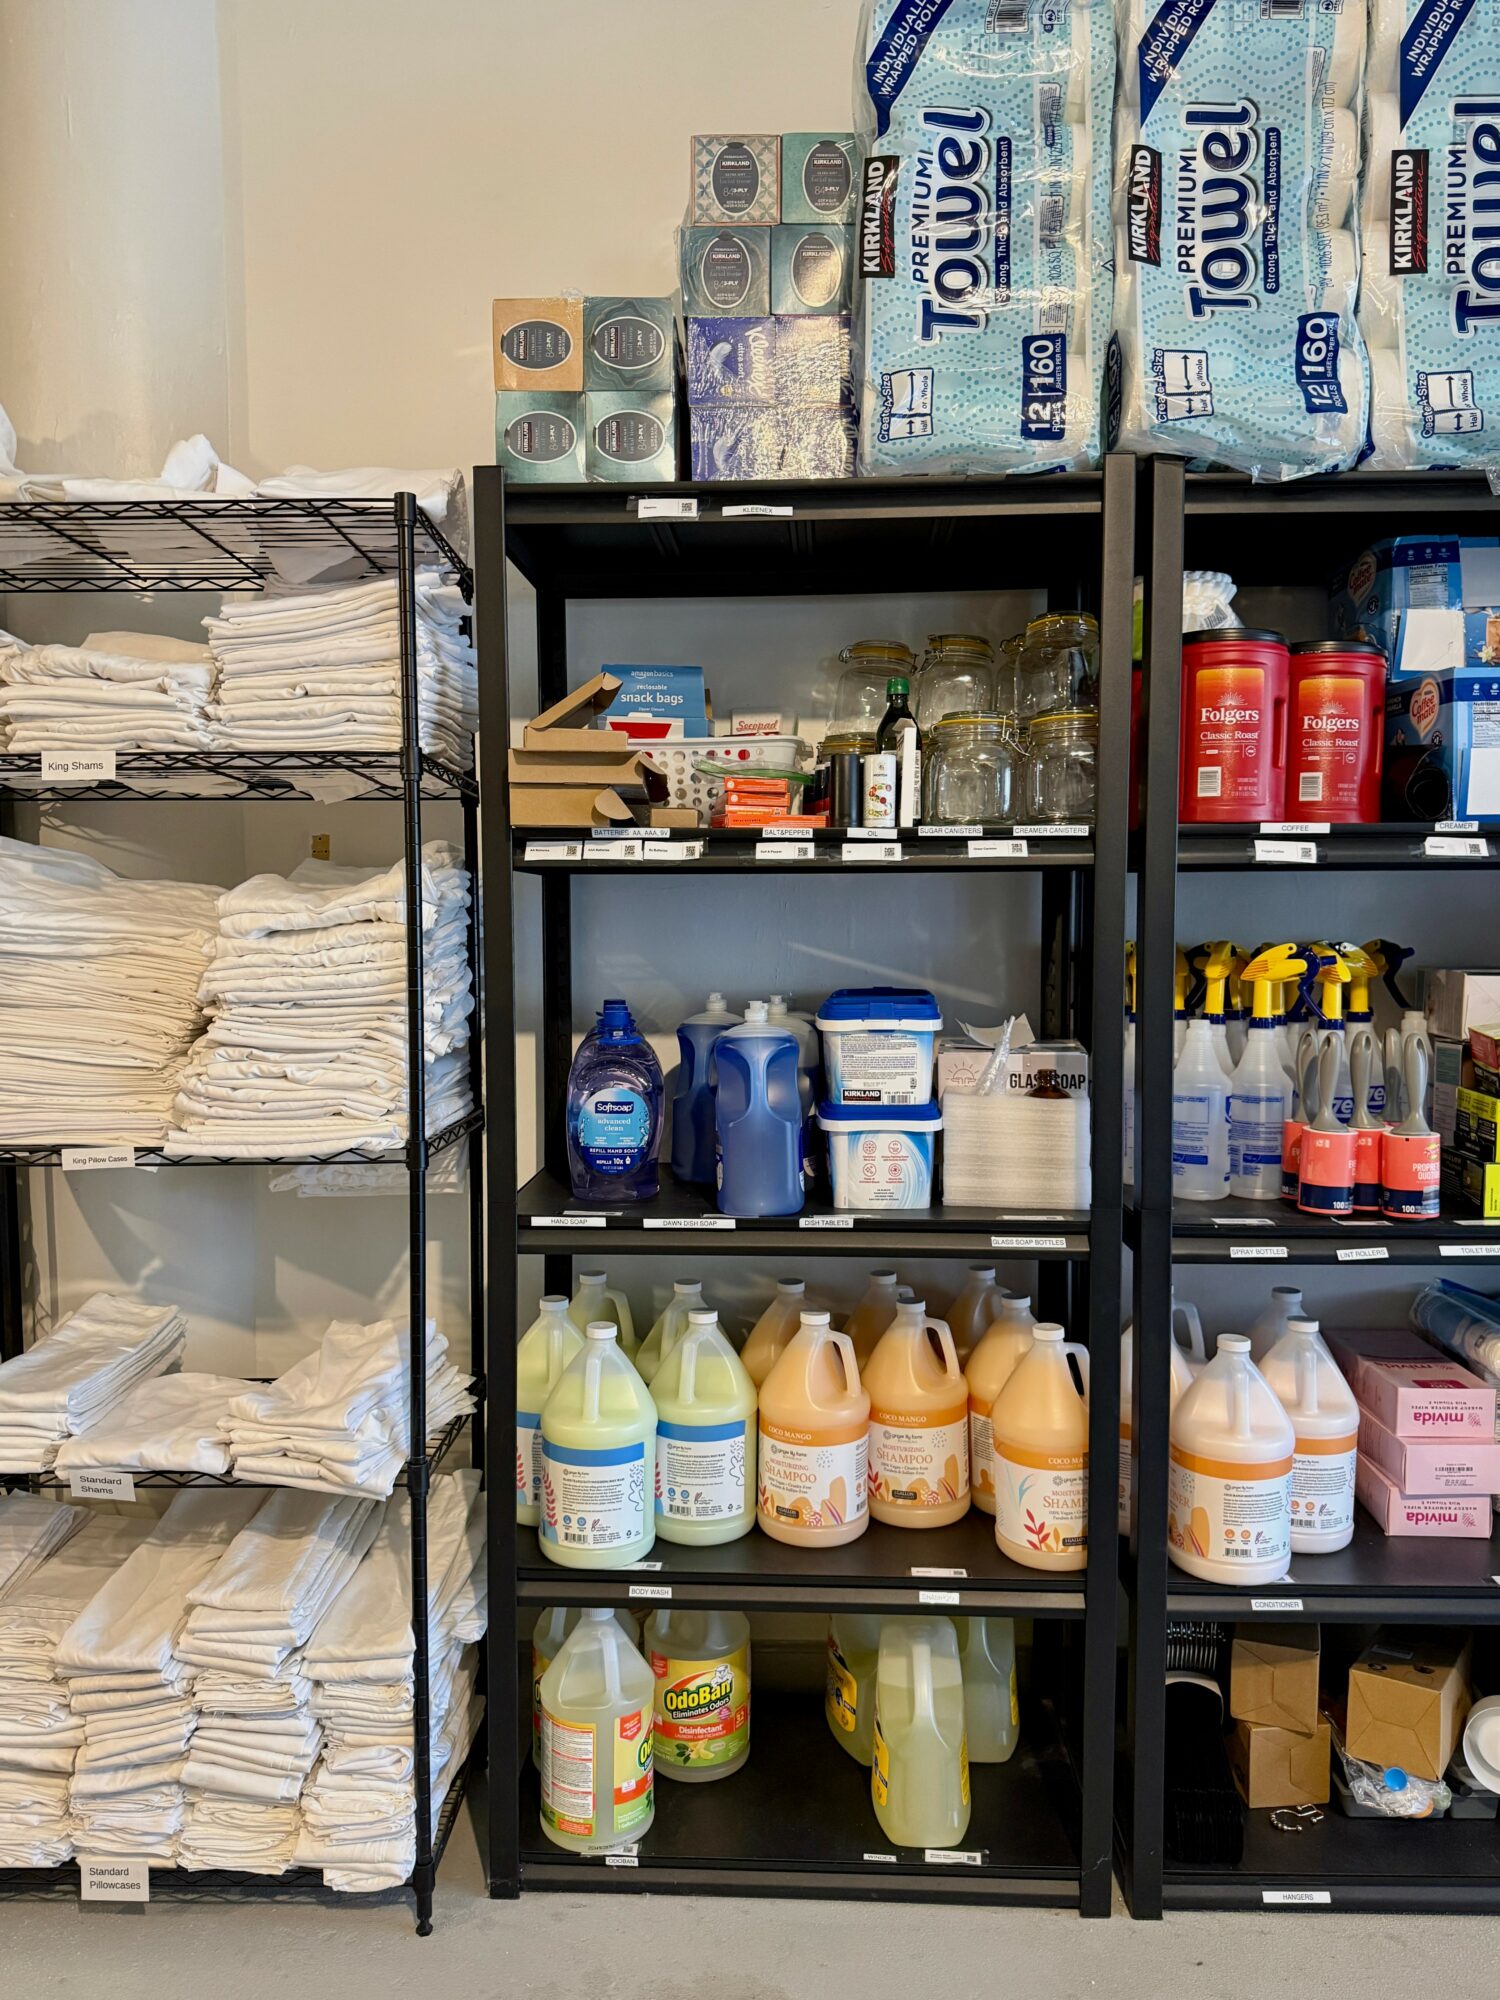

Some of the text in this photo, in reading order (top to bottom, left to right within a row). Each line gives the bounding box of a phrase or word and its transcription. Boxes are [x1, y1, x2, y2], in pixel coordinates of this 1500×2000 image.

[1411, 12, 1455, 77] WRAPPED
[878, 34, 917, 96] WRAPPED
[1267, 132, 1278, 185] Absorbent
[998, 140, 1010, 197] Absorbent
[1131, 150, 1152, 258] KIRKLAND
[1178, 150, 1197, 273] PREMIUM
[1186, 106, 1250, 318] Towel
[1393, 154, 1414, 268] KIRKLAND
[1447, 146, 1467, 275] PREMIUM
[863, 160, 885, 272] KIRKLAND
[912, 151, 933, 283] PREMIUM
[921, 110, 984, 340] Towel
[1265, 251, 1277, 290] Strong,
[1054, 338, 1062, 352] ROLL
[1301, 317, 1328, 376] 160
[1327, 337, 1335, 351] PER
[736, 343, 745, 378] ultra soft
[743, 326, 769, 398] Kleenex
[1029, 340, 1054, 388] 160
[1054, 354, 1062, 364] PER
[1326, 352, 1334, 378] SHEETS
[1307, 384, 1333, 406] 12
[1329, 384, 1343, 407] ROLLS
[1027, 402, 1050, 432] 12
[1469, 413, 1478, 428] Half
[621, 692, 684, 706] snack bags
[1412, 694, 1435, 717] Coffee
[1200, 708, 1260, 725] Folgers
[1416, 704, 1436, 725] mate
[1302, 715, 1359, 733] Folgers
[1200, 730, 1259, 740] Classic Roast
[1302, 738, 1359, 747] Classic Roast
[48, 761, 104, 772] King Shams
[597, 1103, 632, 1113] Softsoap
[1402, 1205, 1415, 1213] 100
[1231, 1248, 1254, 1256] SPRAY
[1356, 1249, 1386, 1258] ROLLERS
[898, 1415, 927, 1423] MANGO
[1413, 1412, 1464, 1425] mivida
[784, 1431, 812, 1440] MANGO
[877, 1447, 933, 1464] SHAMPOO
[1048, 1457, 1070, 1465] COCO
[79, 1475, 122, 1485] Standard
[765, 1460, 816, 1483] SHAMPOO
[81, 1485, 114, 1494] Shams
[1406, 1512, 1458, 1526] mivida
[1254, 1601, 1300, 1609] CONDITIONER
[666, 1681, 731, 1710] OdoBan
[672, 1696, 730, 1719] Eliminates Odors
[679, 1724, 723, 1734] Disinfectant
[89, 1867, 129, 1876] Standard
[89, 1880, 141, 1889] Pillowcases
[1282, 1893, 1314, 1901] HANGERS
